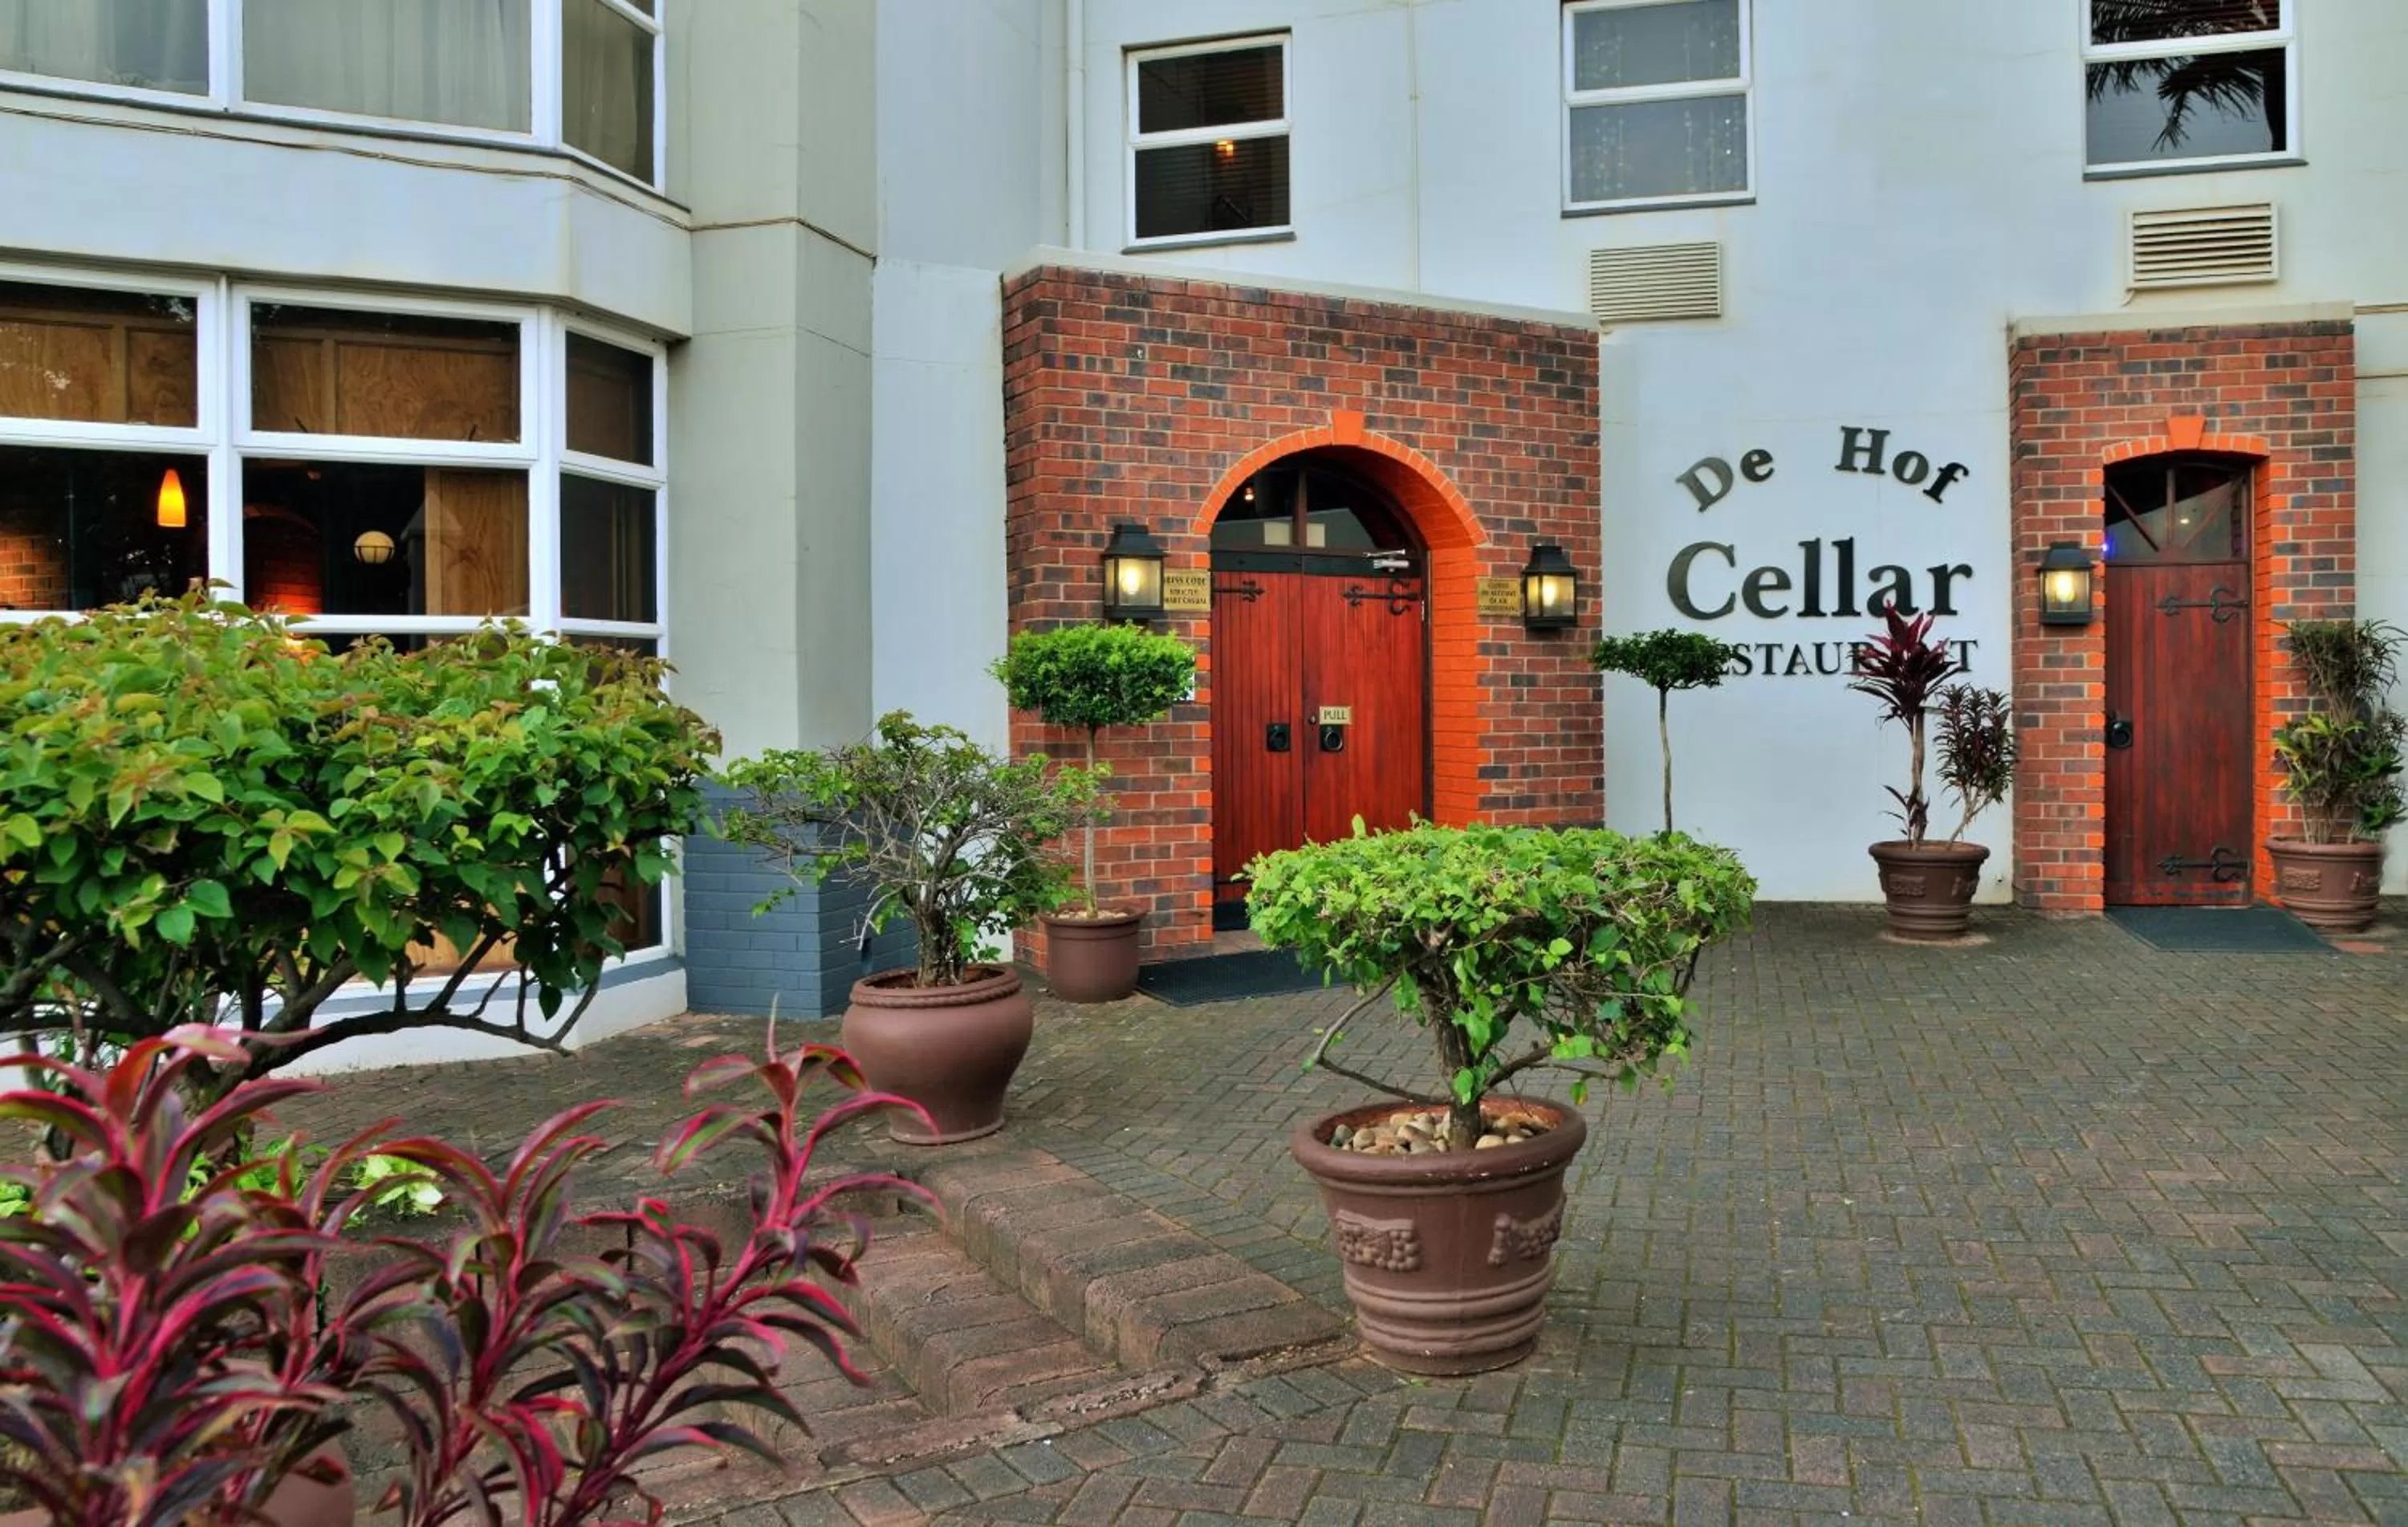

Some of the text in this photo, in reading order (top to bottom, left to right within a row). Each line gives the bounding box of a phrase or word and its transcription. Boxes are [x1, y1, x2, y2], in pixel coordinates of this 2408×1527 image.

[1675, 426, 1970, 512] De Hof
[1165, 575, 1184, 585] RESS
[1667, 536, 1974, 621] Cellar
[1165, 597, 1182, 605] MART
[1324, 709, 1348, 720] PULL
